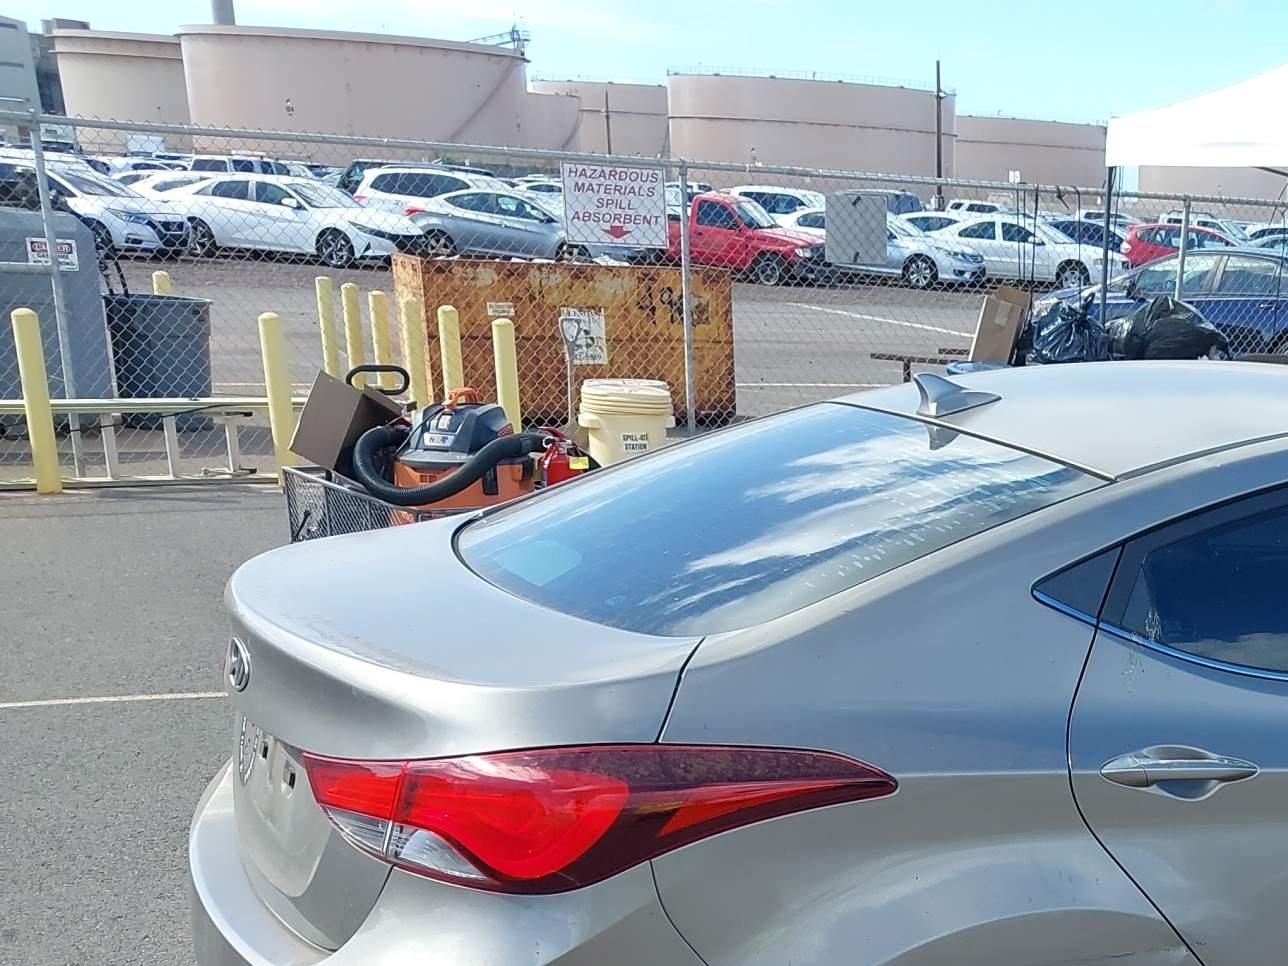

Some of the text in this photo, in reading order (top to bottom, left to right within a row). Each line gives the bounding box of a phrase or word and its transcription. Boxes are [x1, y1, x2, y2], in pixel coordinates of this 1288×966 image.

[568, 167, 659, 183] HAZARDOUS
[573, 182, 656, 198] MATERIALS
[595, 197, 635, 211] SPILL
[571, 211, 661, 226] ABSORBENT
